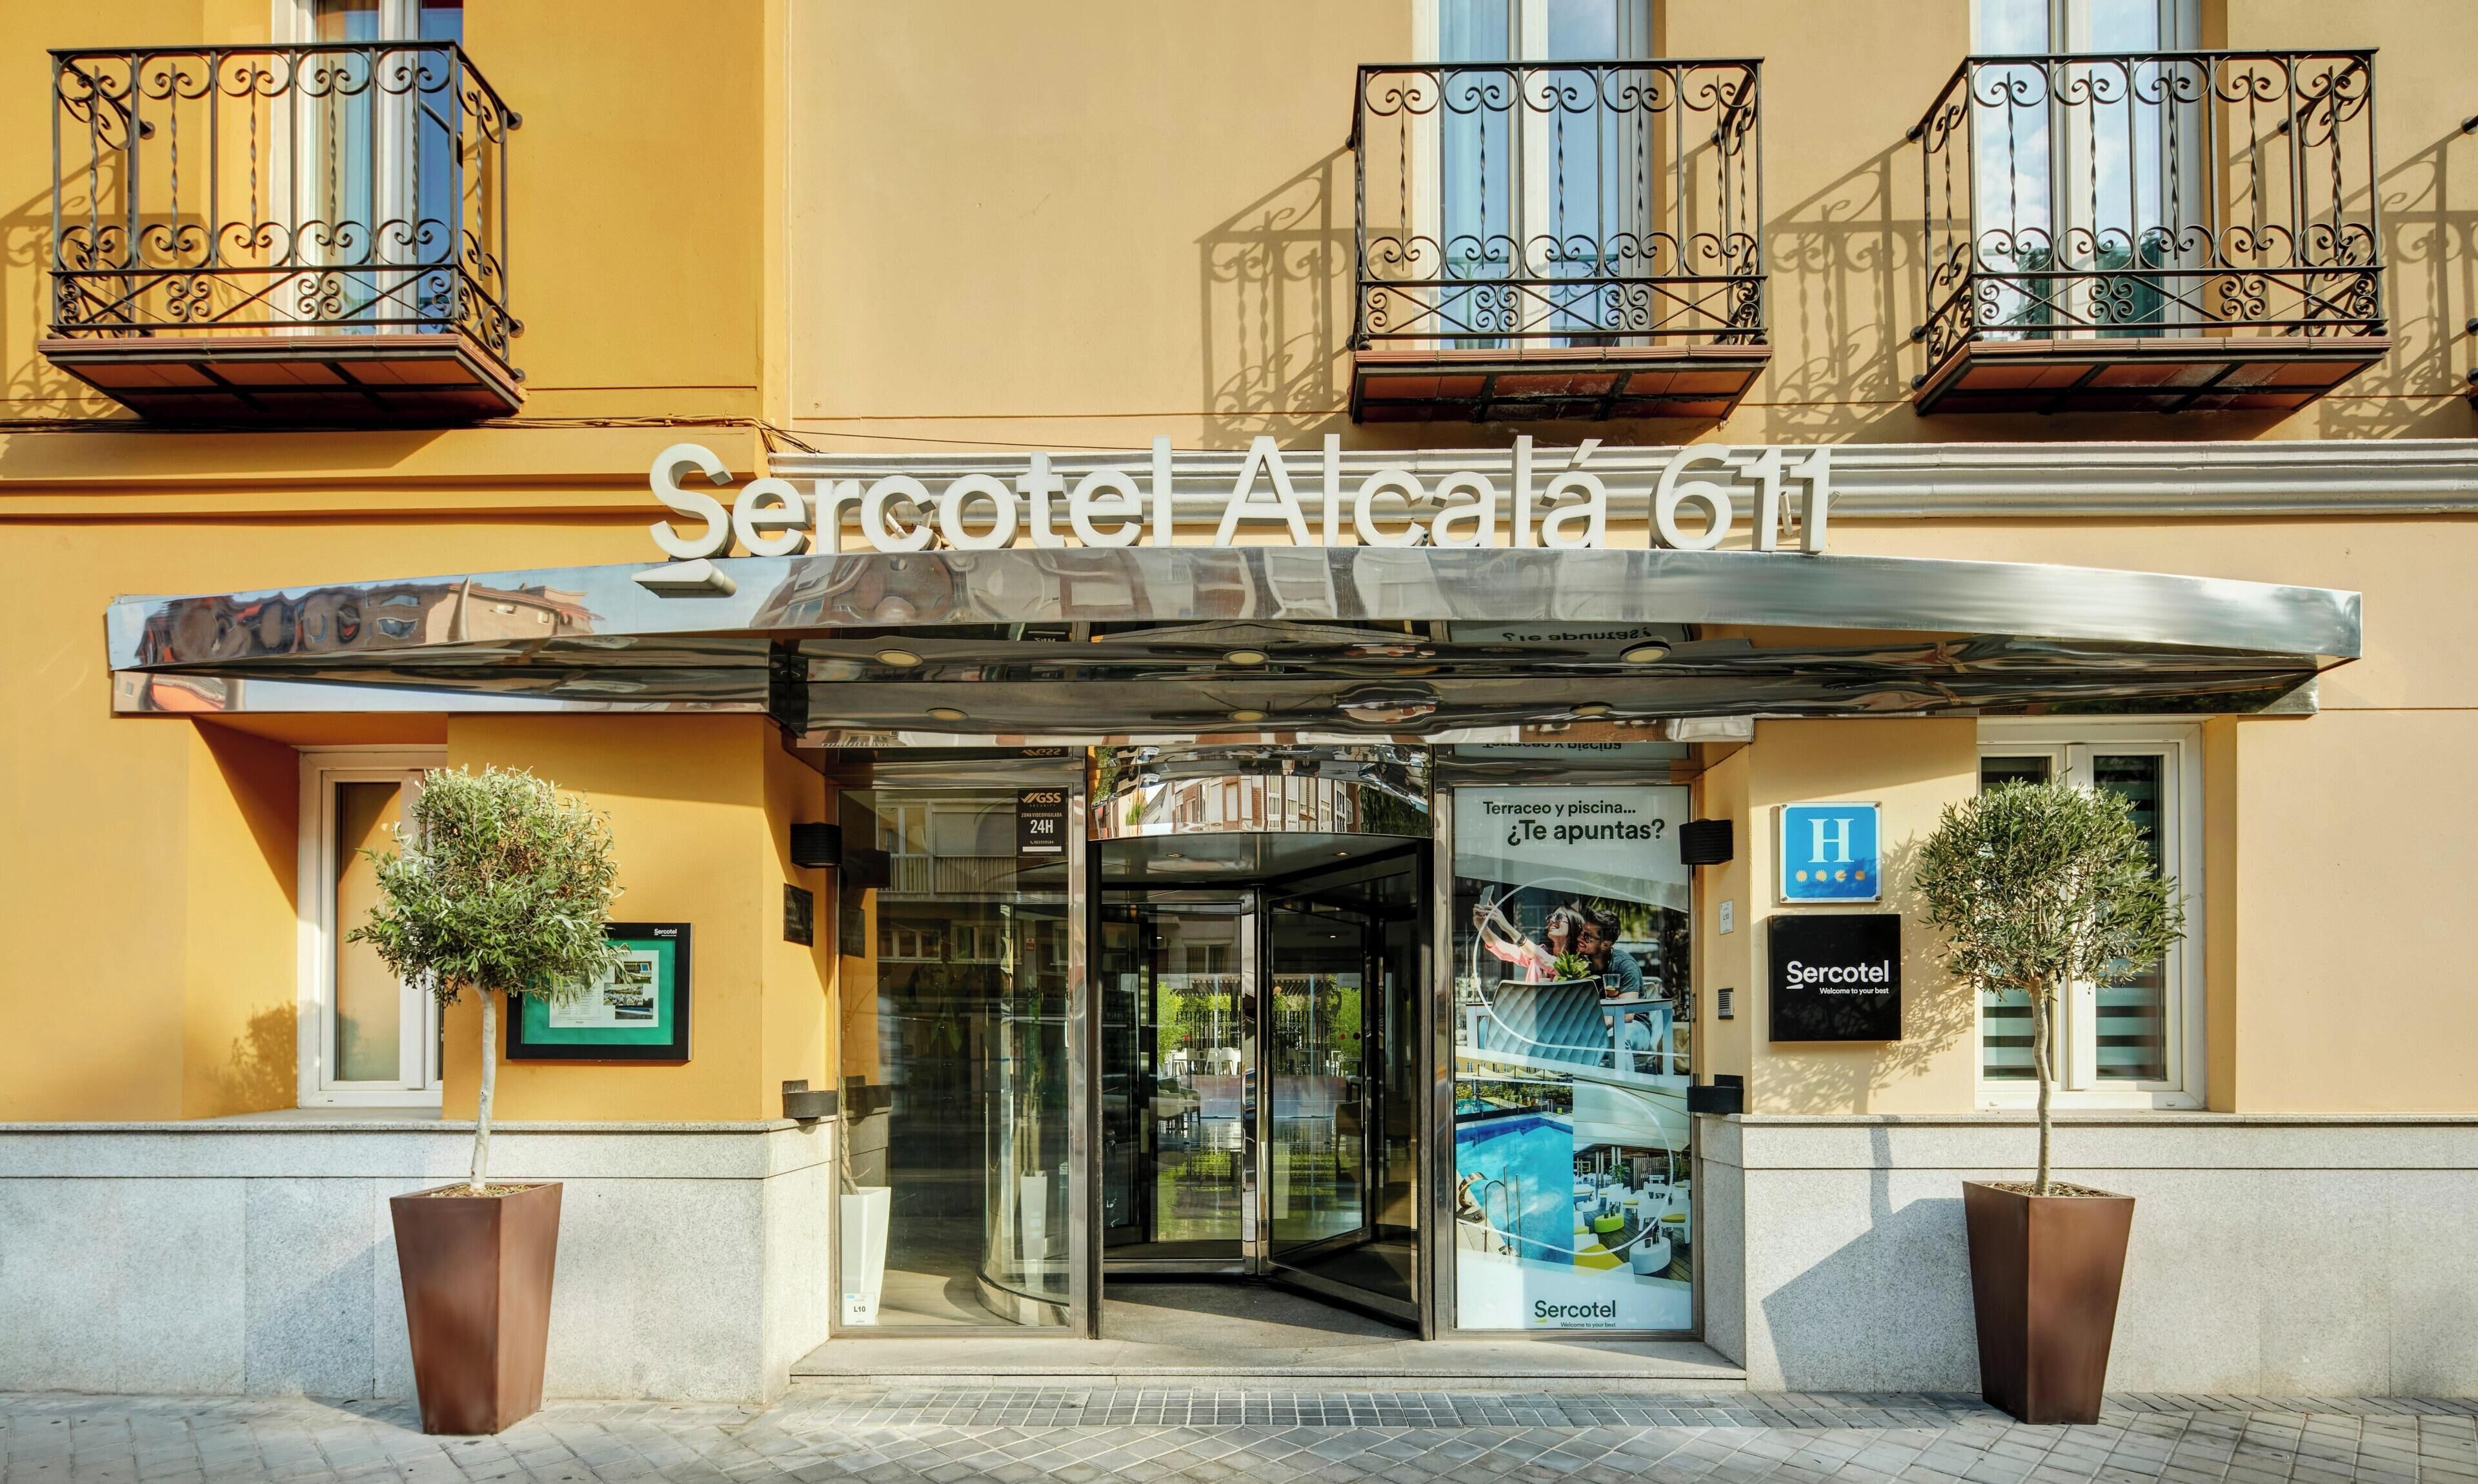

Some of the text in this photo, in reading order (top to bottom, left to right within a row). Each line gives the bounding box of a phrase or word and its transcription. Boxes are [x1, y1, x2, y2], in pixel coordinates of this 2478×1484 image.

[649, 433, 1830, 559] Sercotel Alcalá 611
[1036, 792, 1062, 803] GSS
[1482, 800, 1636, 817] Terraceo y piscina...
[1030, 819, 1053, 834] 24H
[1507, 818, 1666, 847] ¿Te apuntas?
[1807, 818, 1855, 863] H
[1786, 960, 1889, 983] Sercotel
[1534, 1299, 1616, 1318] Sercotel
